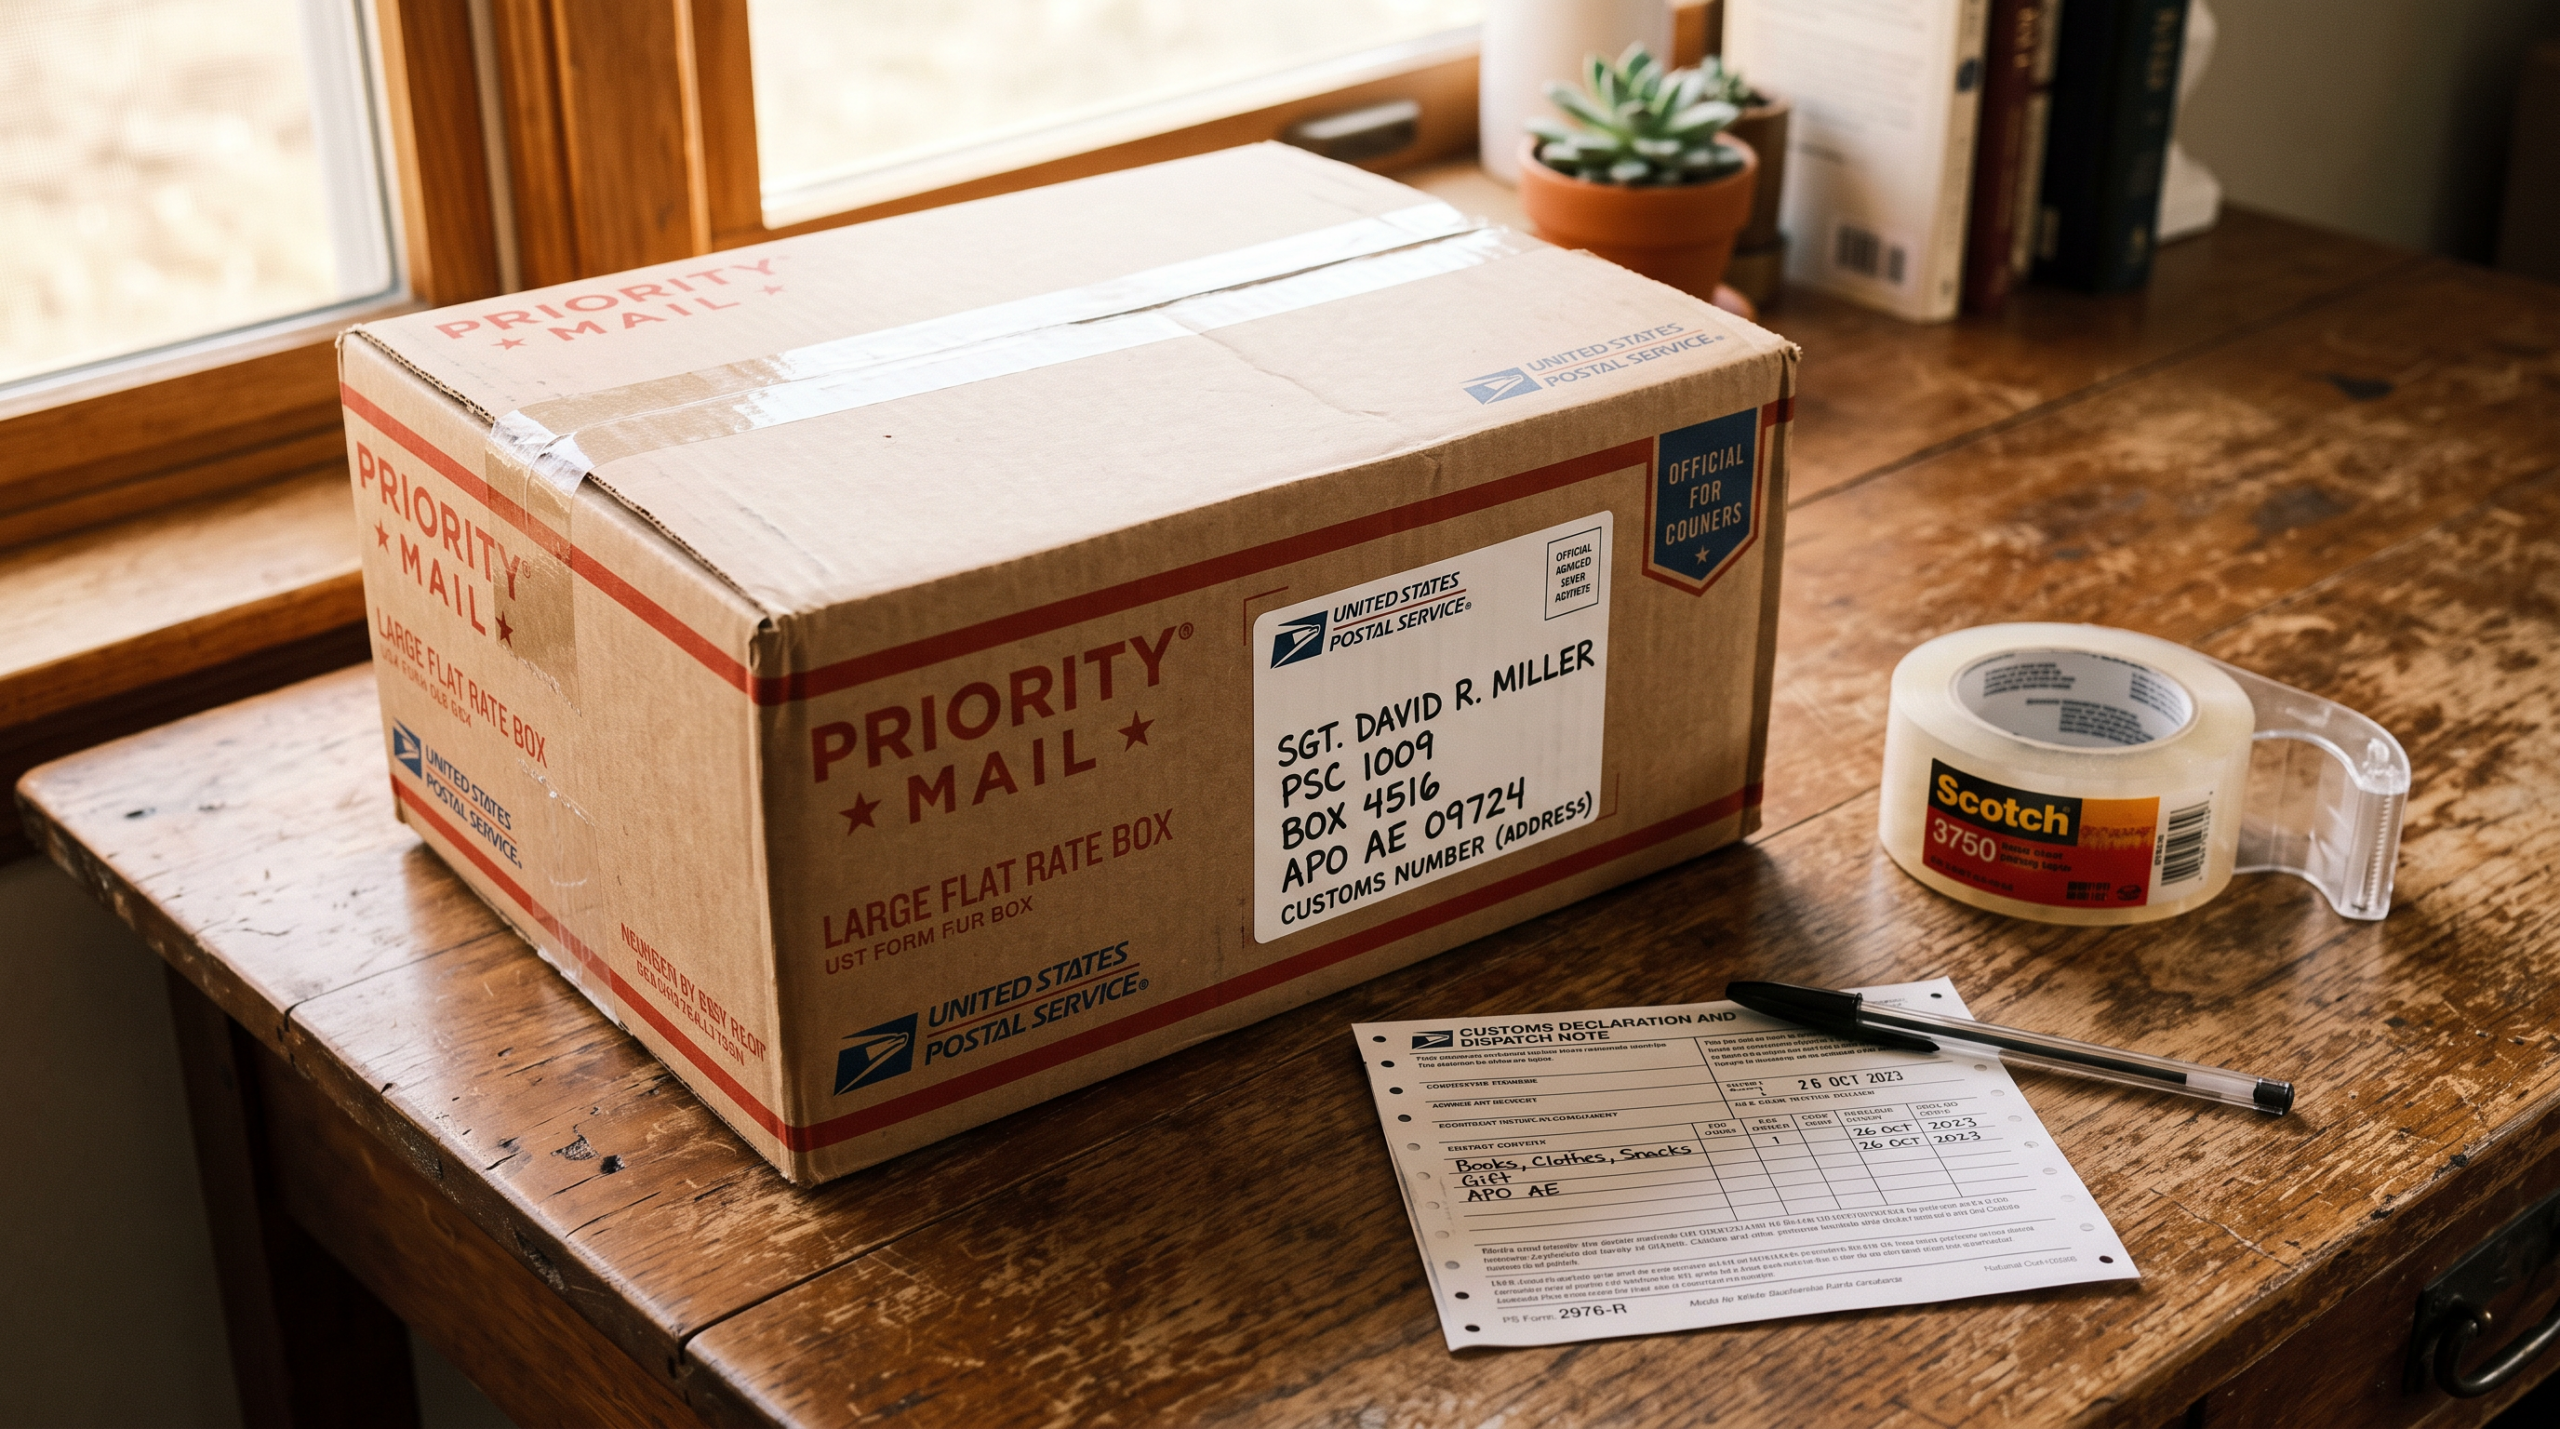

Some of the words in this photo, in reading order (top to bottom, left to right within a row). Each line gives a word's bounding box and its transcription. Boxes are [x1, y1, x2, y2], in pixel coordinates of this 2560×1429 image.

[434, 257, 776, 339] PRIORITY
[547, 296, 741, 341] MAIL
[1526, 343, 1609, 372] UNITED
[1607, 322, 1684, 350] STATES
[1543, 359, 1630, 387] POSTAL
[1669, 444, 1744, 486] OFFICIAL
[1689, 480, 1721, 509] FOR
[1665, 502, 1742, 546] COUNERS
[1556, 543, 1592, 562] OFFICIAL
[400, 534, 486, 637] MAIL
[1333, 590, 1398, 623] UNITED
[1400, 571, 1460, 603] STATES
[1561, 572, 1586, 588] SEVER
[1329, 619, 1394, 652] POSTAL
[377, 606, 424, 669] LARGE
[428, 646, 464, 700] FLAT
[468, 679, 509, 738] RATE
[513, 714, 548, 769] BOX
[1277, 720, 1343, 767] SGT.
[1355, 692, 1442, 743] DAVID
[1455, 678, 1482, 711] R.
[1492, 639, 1595, 699] MILLER
[426, 745, 470, 793] UNITED
[472, 784, 511, 830] STATES
[907, 728, 1096, 825] MAIL
[1282, 761, 1346, 808] PSC
[1364, 729, 1434, 781] 1009
[427, 772, 468, 821] POSTAL
[1282, 802, 1347, 850] BOX
[1363, 771, 1440, 819] 4516
[1937, 774, 2069, 836] Scotch
[1282, 845, 1348, 893] APO
[1364, 820, 1407, 864] AE
[1424, 776, 1525, 839] 09724
[1933, 818, 1996, 862] 3750
[823, 885, 931, 949] LARGE
[941, 858, 1016, 913] FLAT
[1026, 830, 1103, 886] RATE
[1113, 808, 1174, 859] BOX
[1281, 872, 1386, 925] CUSTOMS
[1394, 835, 1485, 885] NUMBER
[825, 949, 867, 975] UST
[874, 927, 935, 961] FORM
[991, 895, 1034, 923] BOX
[680, 973, 695, 1002] BY
[929, 975, 1032, 1028] UNITED
[1035, 940, 1129, 993] STATES
[925, 1013, 1026, 1066] POSTAL
[1459, 1023, 1554, 1037] CUSTOMS
[1559, 1014, 1692, 1032] DECLARATION
[1697, 1011, 1737, 1023] AND
[1460, 1033, 1553, 1048] DISPATCH
[1558, 1030, 1610, 1042] NOTE
[1798, 1077, 1822, 1090] 26
[1829, 1074, 1860, 1087] OCT
[1853, 1126, 1877, 1137] 26
[1928, 1117, 1977, 1130] 2023
[1859, 1140, 1883, 1150] 26
[1889, 1136, 1920, 1147] OCT
[1933, 1131, 1981, 1144] 2023
[1455, 1158, 1526, 1173] Books,
[1531, 1151, 1615, 1167] Clothes,
[1619, 1145, 1692, 1160] Snacks
[1461, 1171, 1512, 1187] Gift
[1467, 1187, 1512, 1202] APO
[1528, 1182, 1560, 1197] AE
[1558, 1303, 1627, 1320] 2976-R
